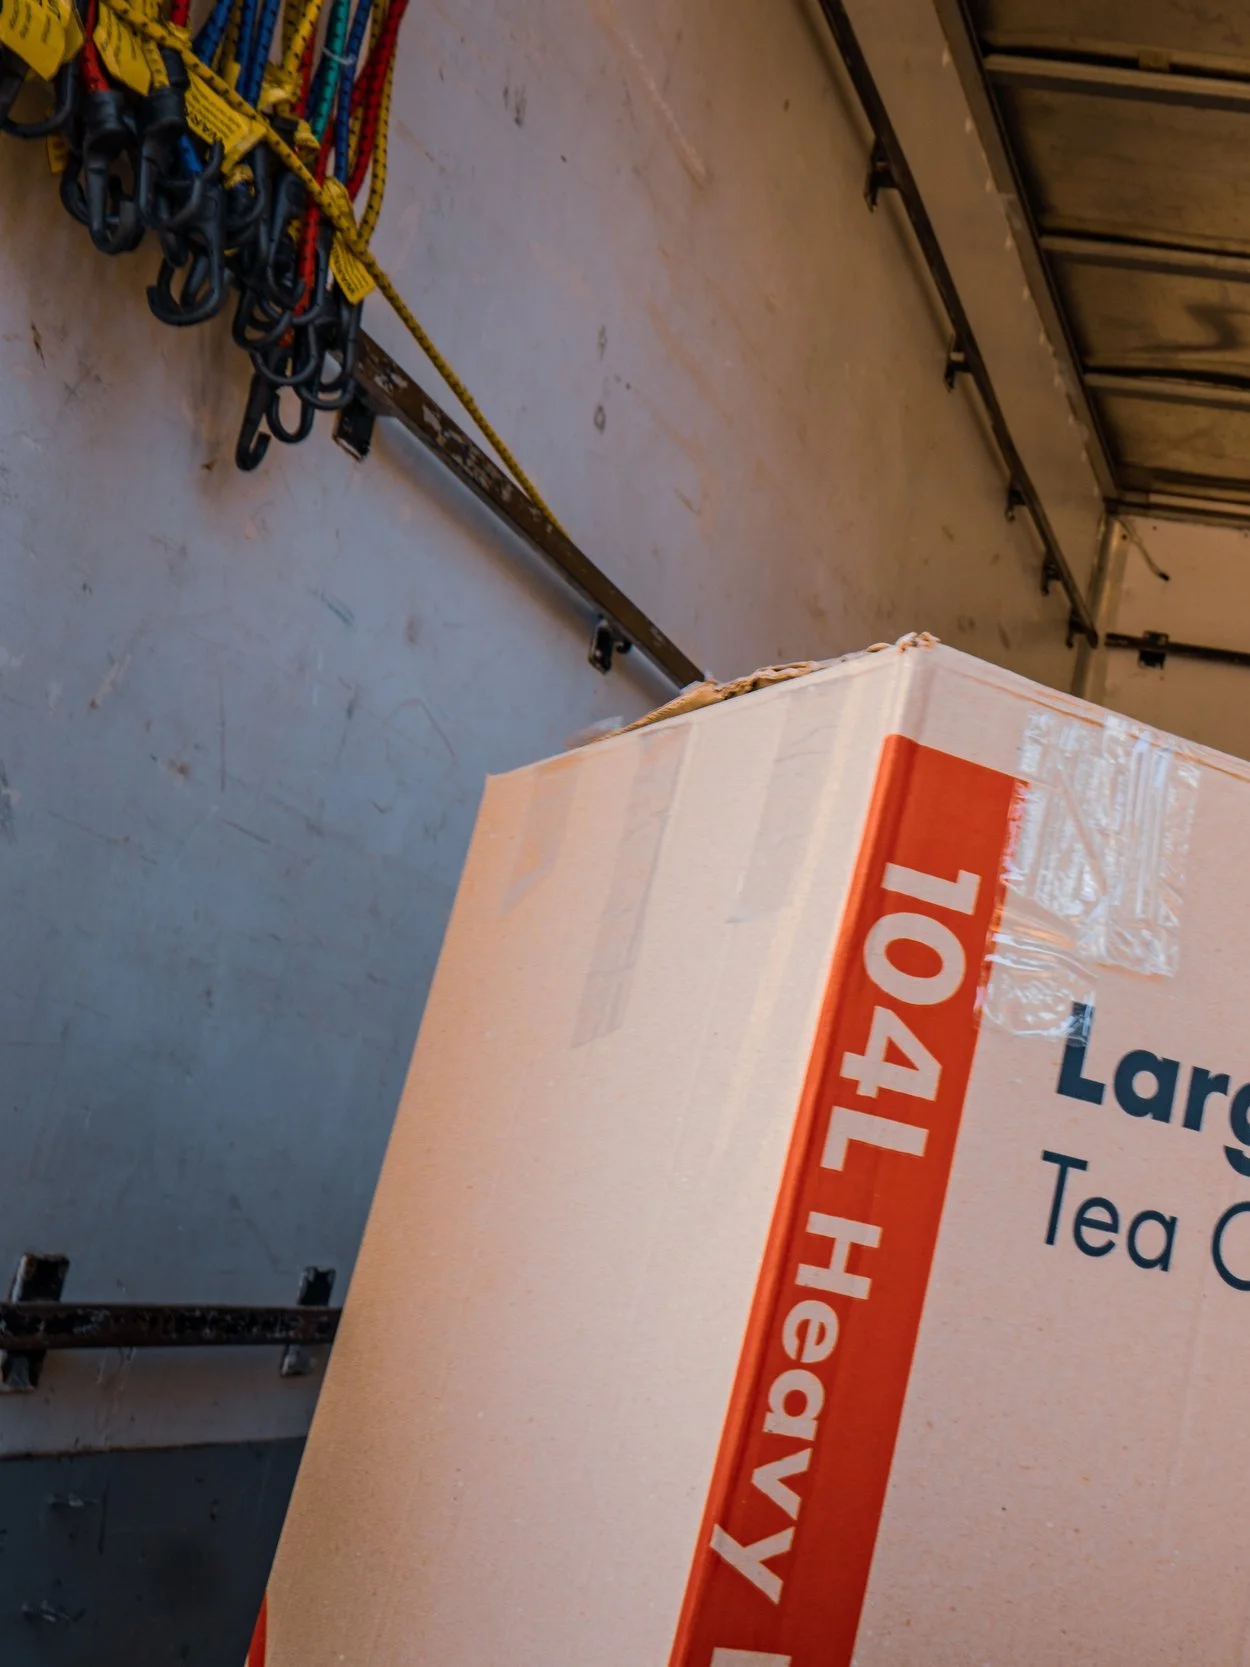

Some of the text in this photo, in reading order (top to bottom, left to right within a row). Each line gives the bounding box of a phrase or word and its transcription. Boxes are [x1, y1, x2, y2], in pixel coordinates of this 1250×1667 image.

[819, 860, 982, 1173] 104L
[1041, 1150, 1178, 1272] Tea
[709, 1211, 882, 1605] Heavy
